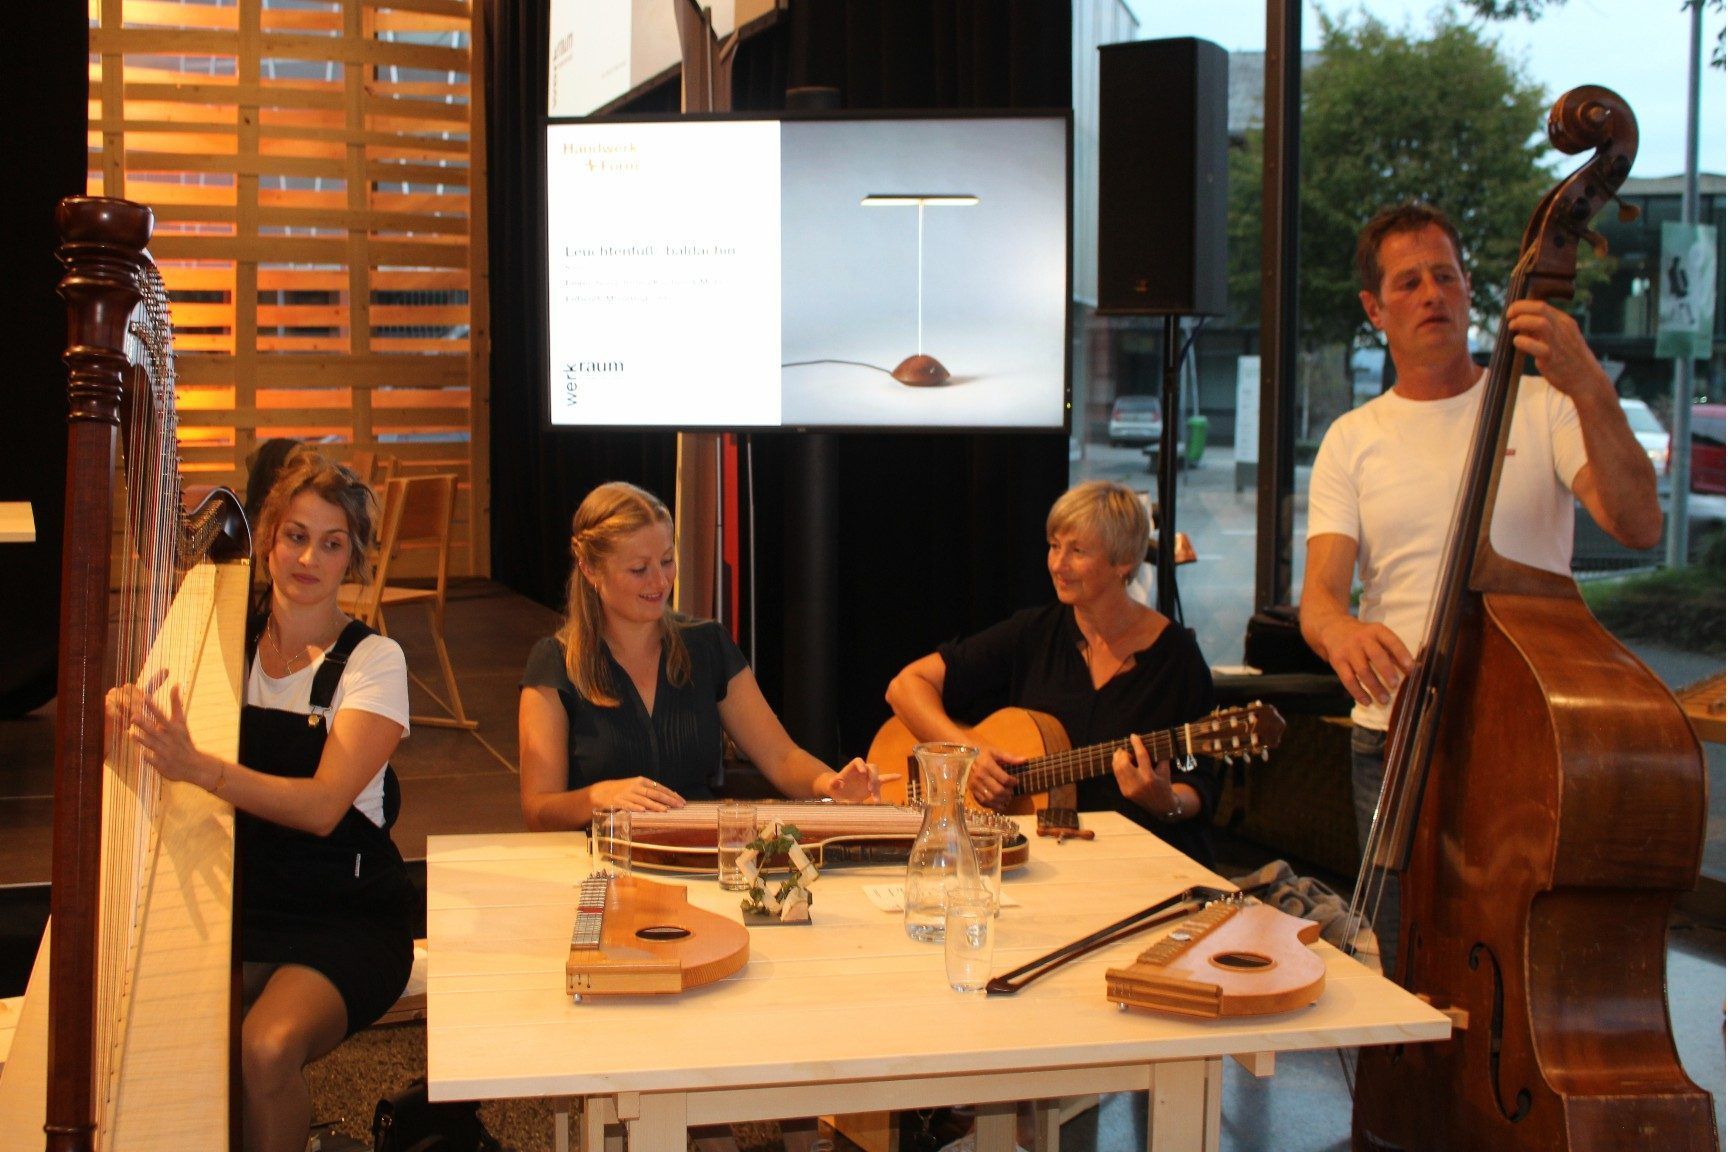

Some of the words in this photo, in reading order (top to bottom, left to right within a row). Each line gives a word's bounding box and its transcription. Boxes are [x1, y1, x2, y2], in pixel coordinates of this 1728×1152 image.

[563, 143, 639, 155] Handwerk
[579, 361, 624, 372] raum
[563, 362, 578, 407] werk
